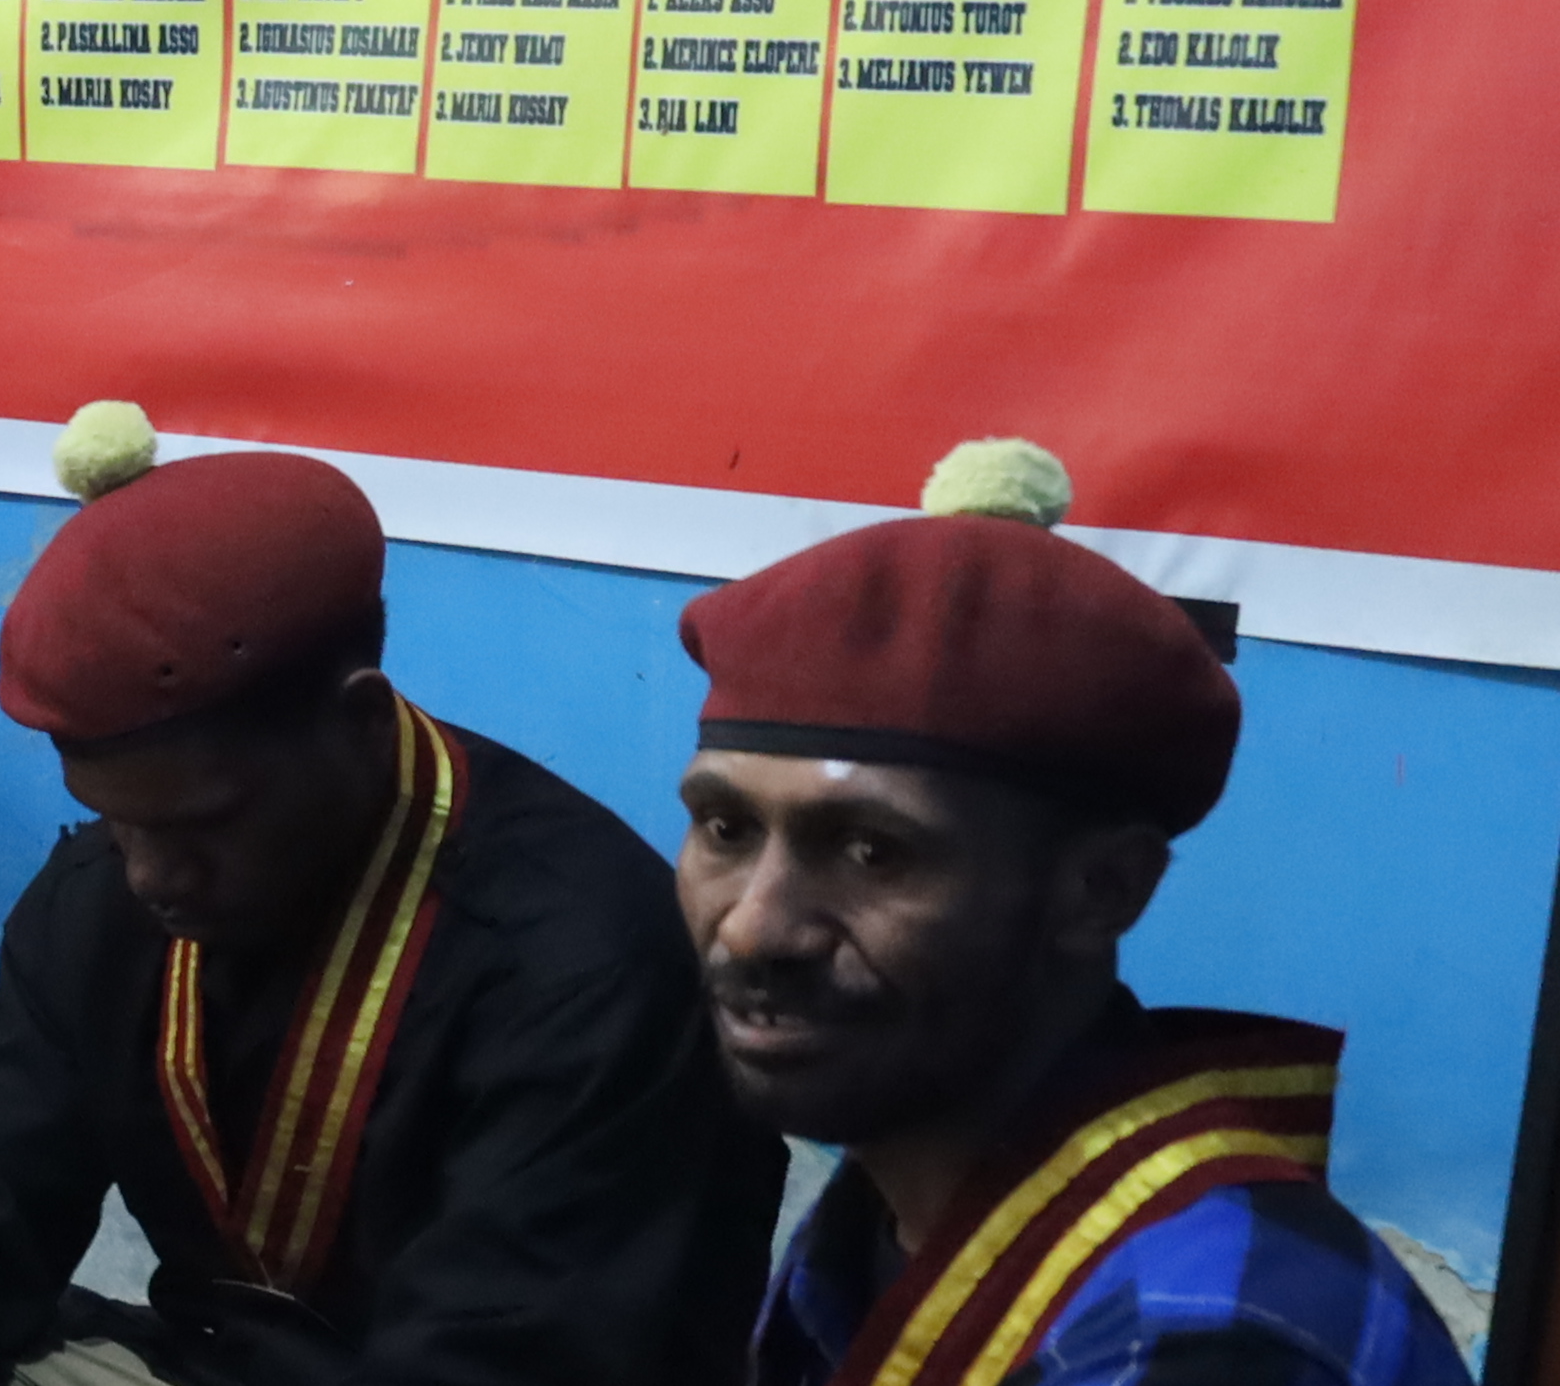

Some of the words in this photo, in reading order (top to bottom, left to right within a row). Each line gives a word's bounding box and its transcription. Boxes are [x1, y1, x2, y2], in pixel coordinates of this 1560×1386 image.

[57, 22, 151, 54] PASKALINA
[158, 24, 199, 55] ASSO
[57, 77, 114, 108] MARIA
